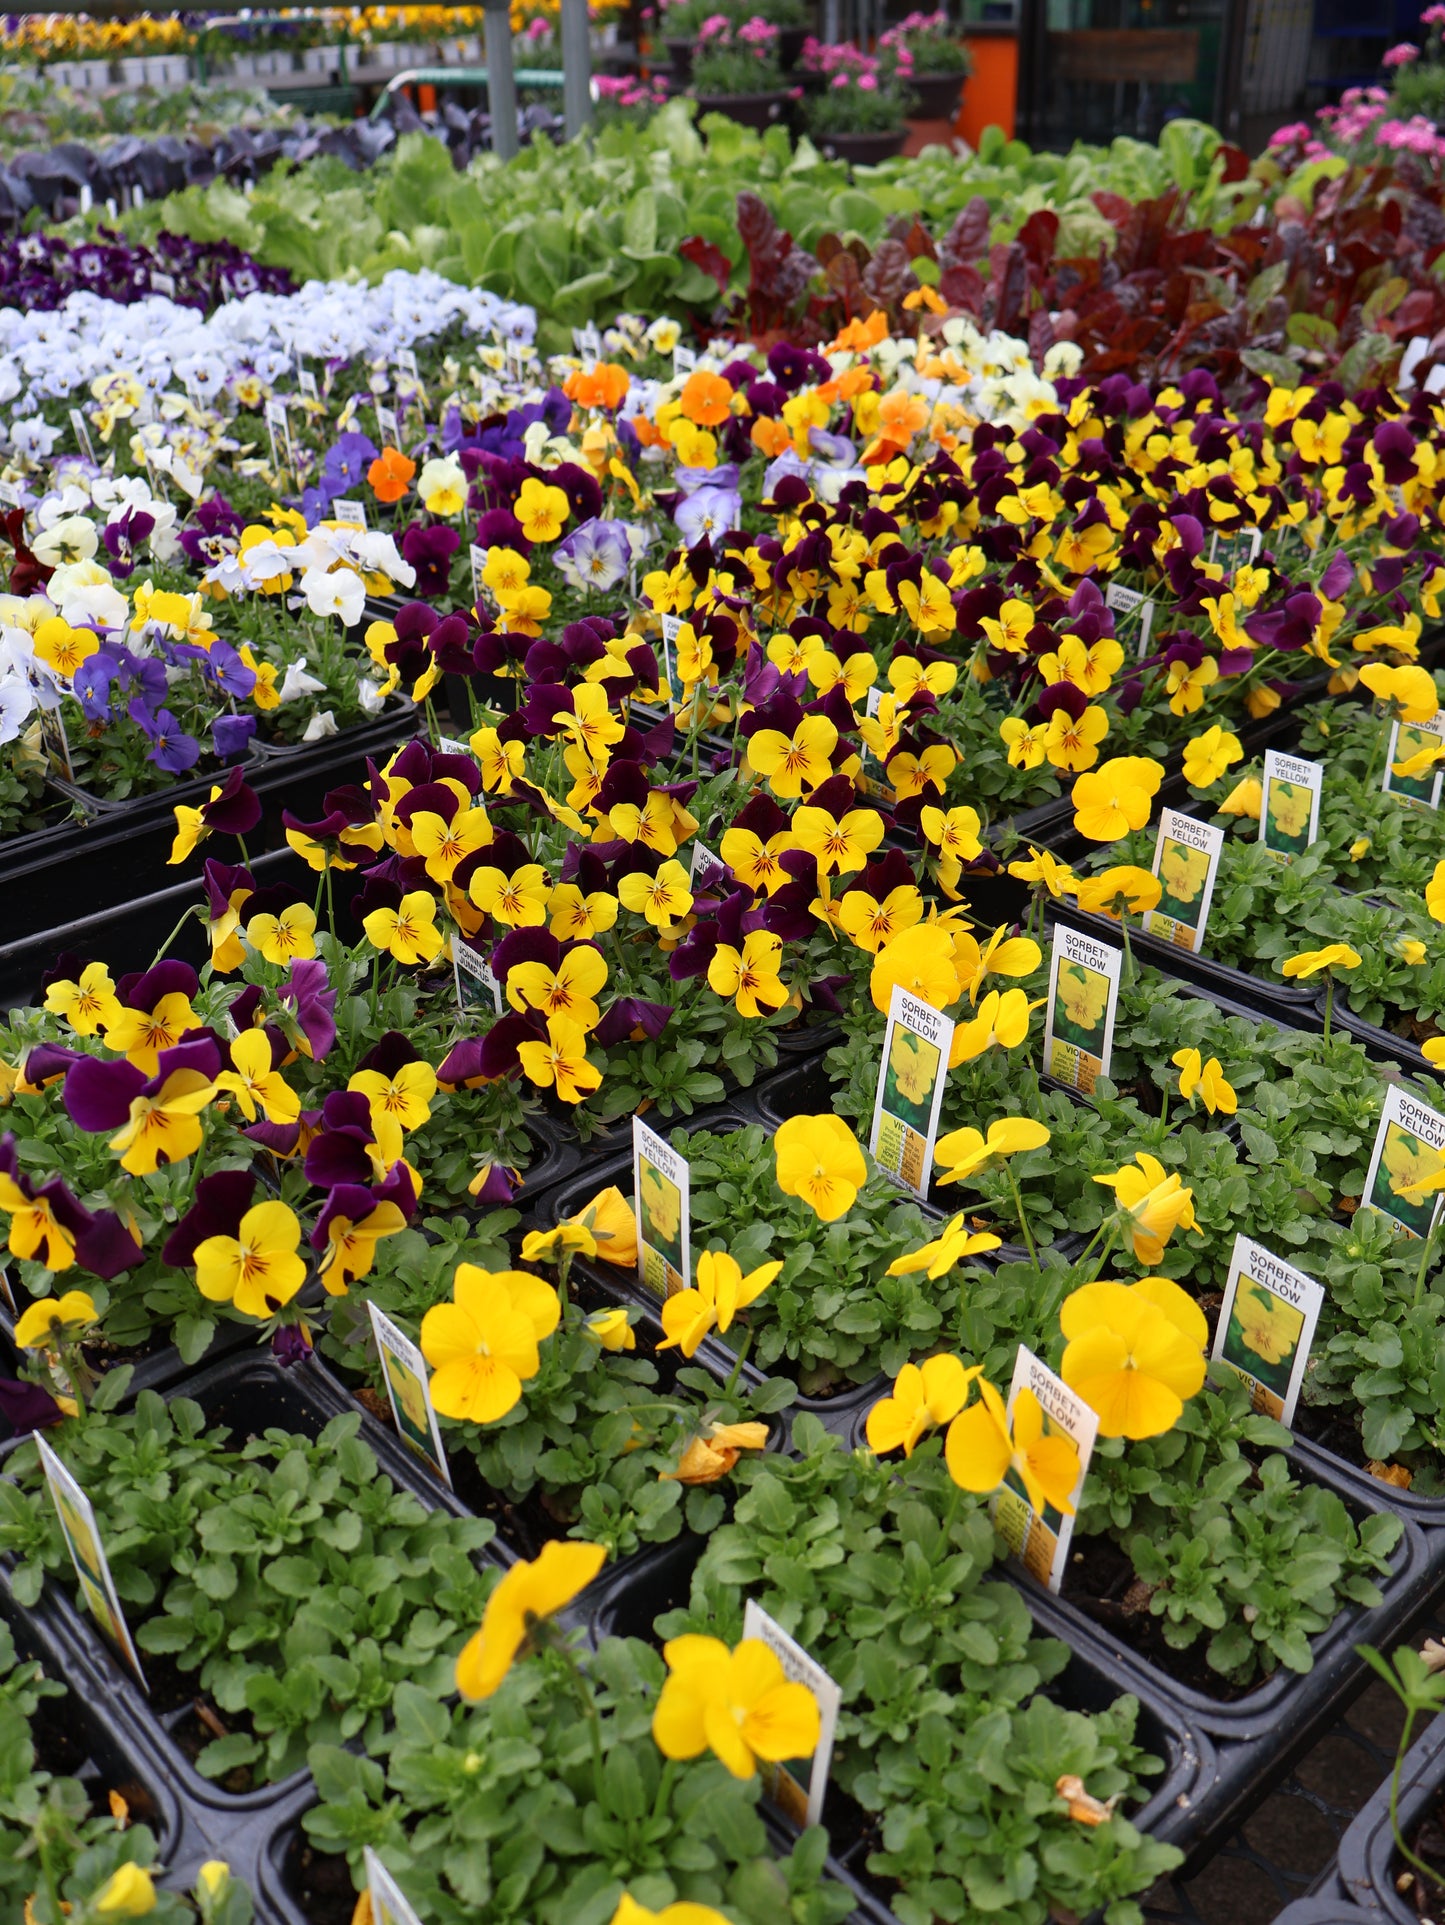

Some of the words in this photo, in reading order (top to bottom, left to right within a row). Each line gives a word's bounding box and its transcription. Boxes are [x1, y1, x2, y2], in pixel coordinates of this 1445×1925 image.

[1275, 768, 1309, 784] YELLOW
[1172, 828, 1208, 849] YELLOW
[1163, 918, 1184, 933] VIOLA
[1066, 946, 1106, 971] YELLOW
[901, 1011, 938, 1041] YELLOW
[1065, 1045, 1089, 1063] VIOLA
[893, 1119, 915, 1141] VIOLA
[1399, 1111, 1445, 1148] YELLOW
[643, 1143, 676, 1180] YELLOW
[1250, 1264, 1301, 1304] YELLOW
[1238, 1371, 1266, 1397] VIOLA
[1030, 1380, 1076, 1430] YELLOW
